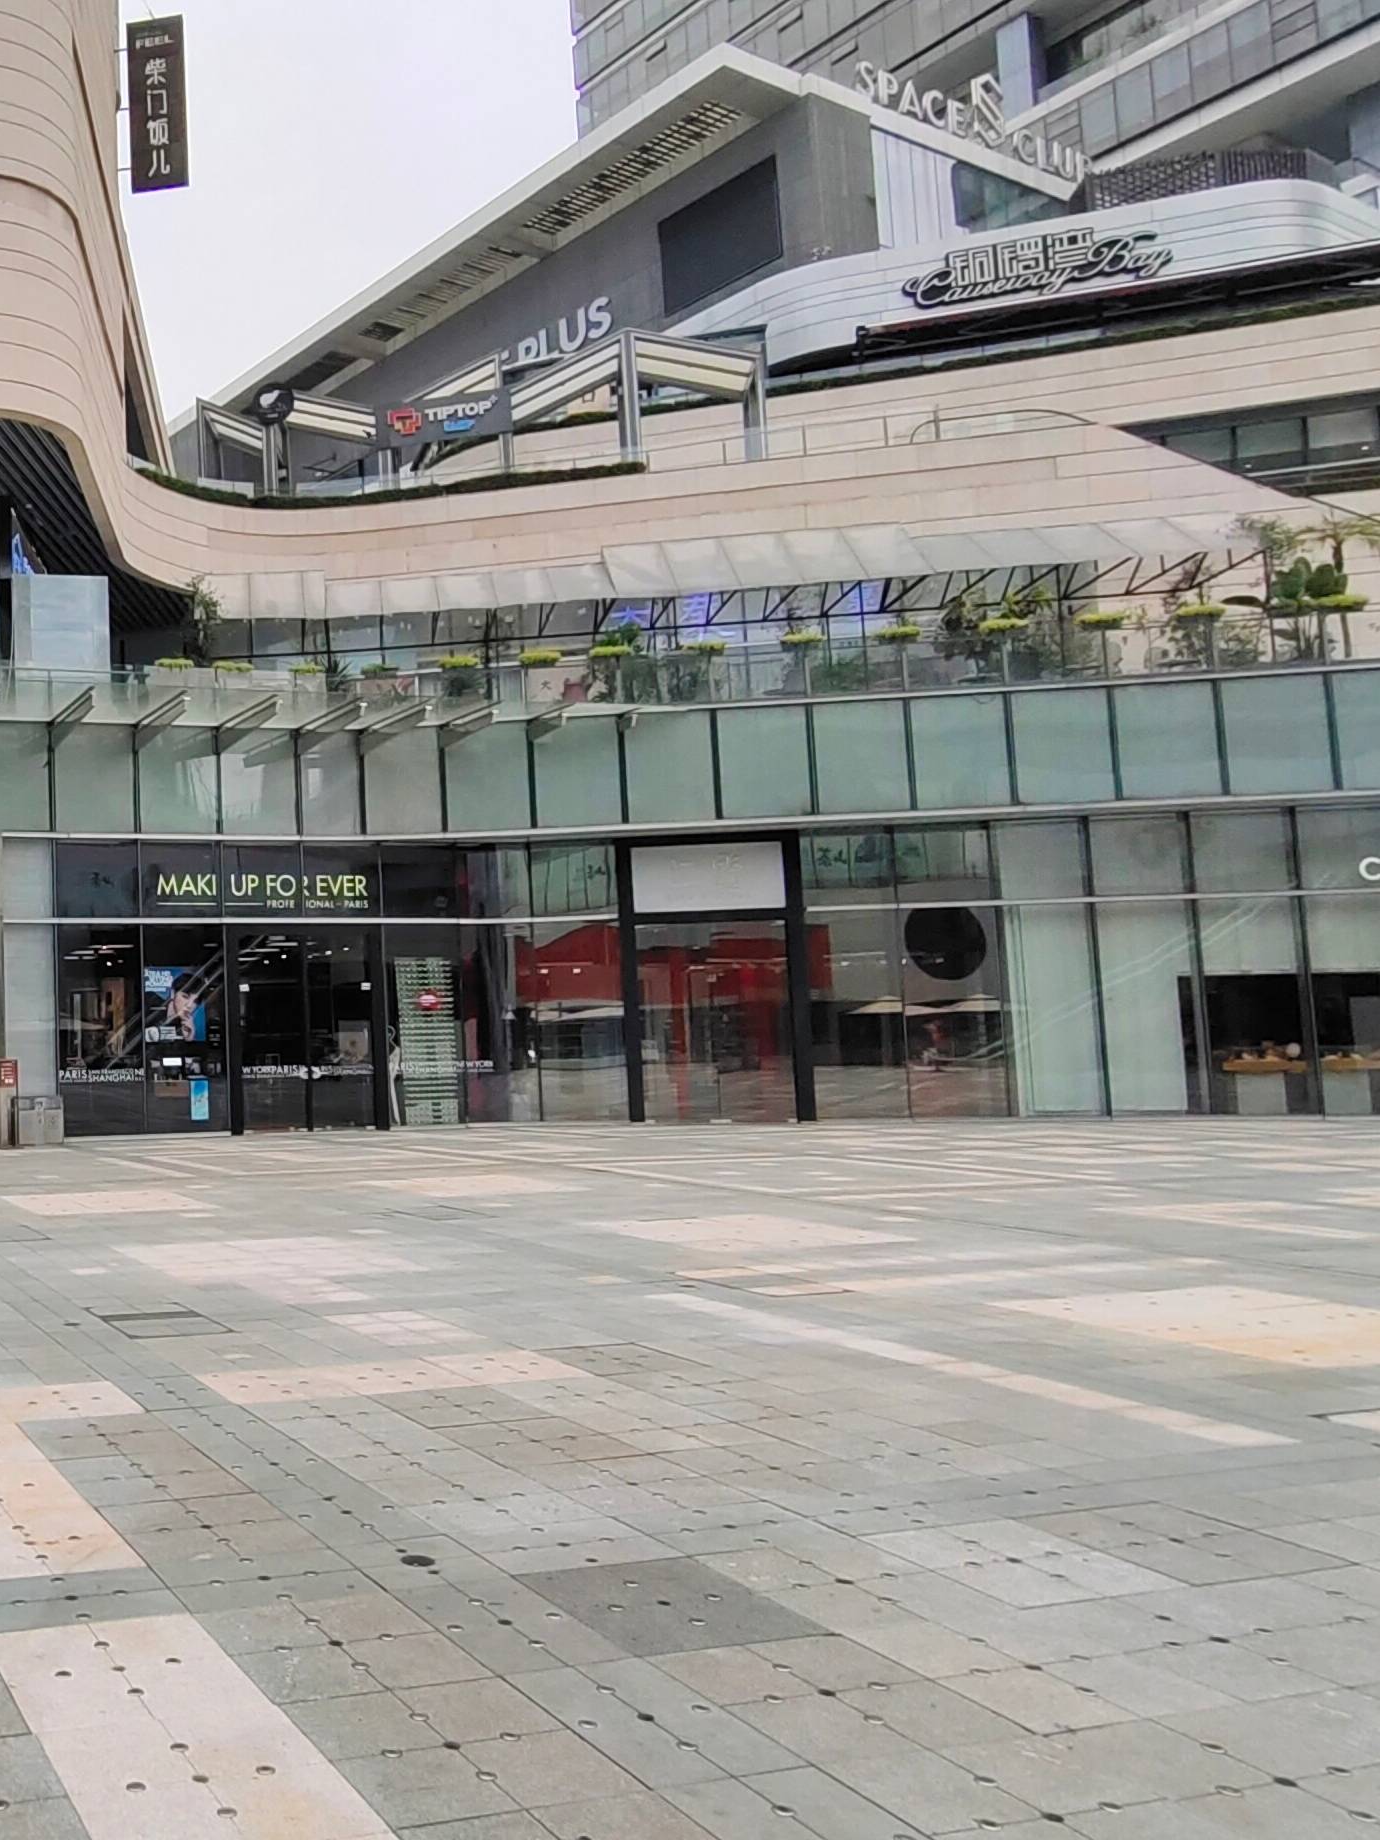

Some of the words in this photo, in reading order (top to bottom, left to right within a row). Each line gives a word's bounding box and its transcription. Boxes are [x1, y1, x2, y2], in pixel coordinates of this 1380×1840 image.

[144, 58, 171, 178] 柴门饭儿
[855, 60, 969, 139] SPACE
[904, 265, 1073, 307] Causeway
[1075, 231, 1174, 279] Bay
[518, 296, 612, 361] PLUS
[424, 400, 493, 422] TIPTOP
[231, 874, 259, 897] UP
[316, 874, 368, 897] EVER
[59, 1069, 87, 1079] PARIS
